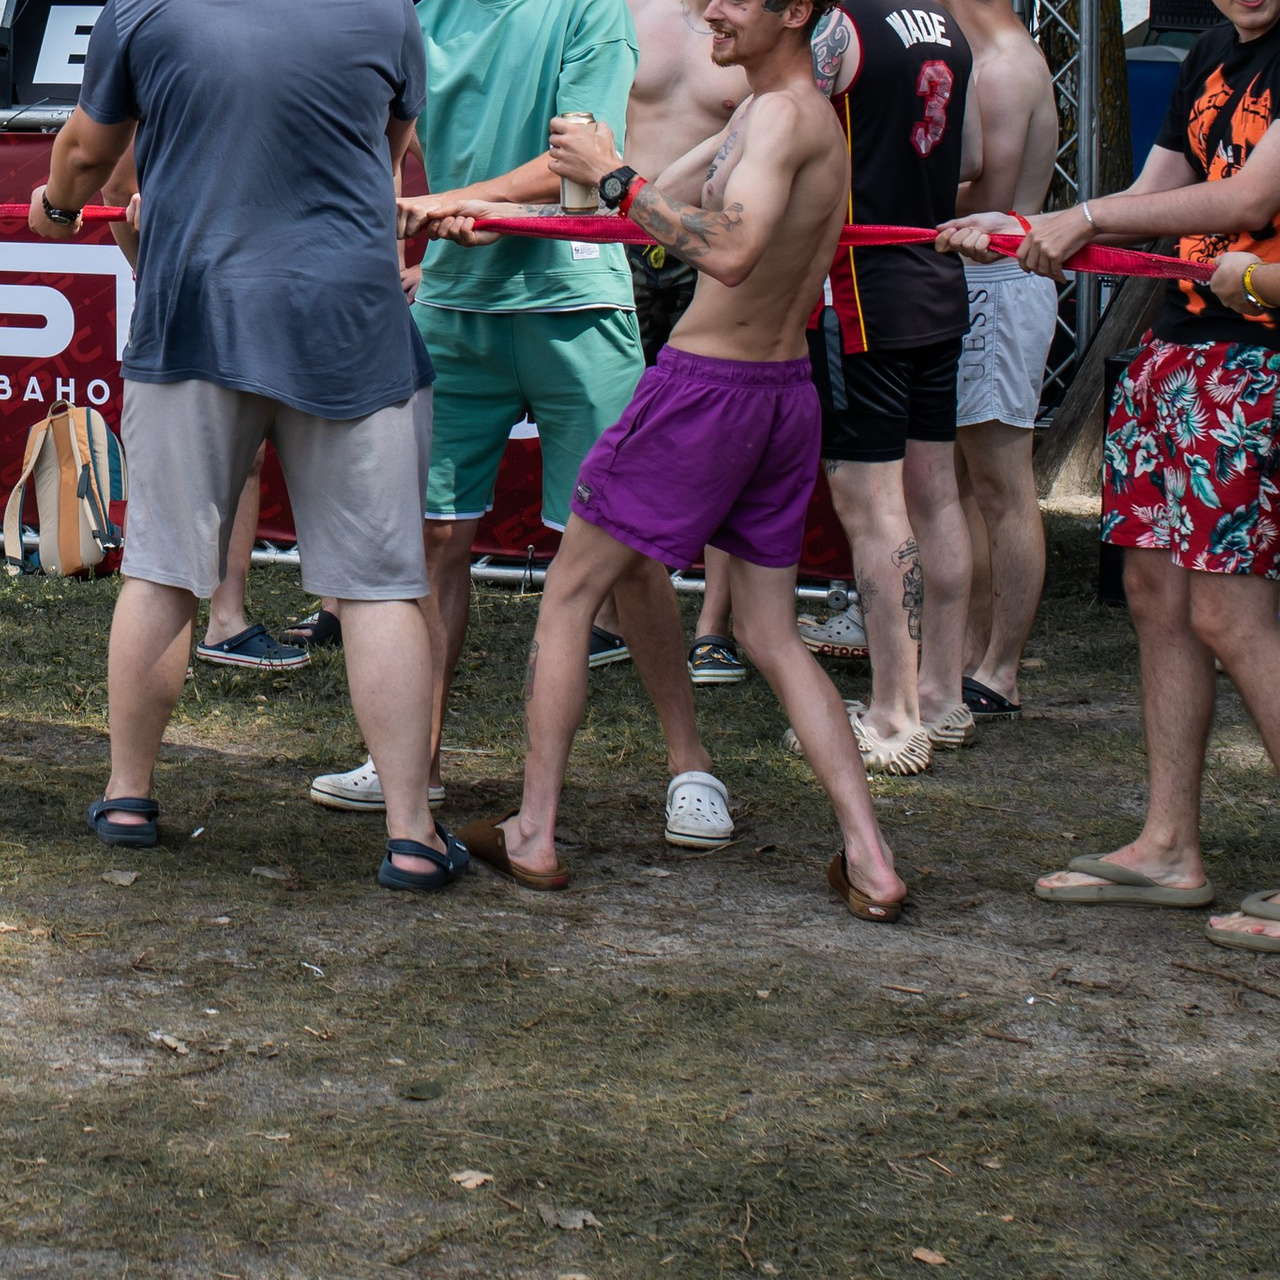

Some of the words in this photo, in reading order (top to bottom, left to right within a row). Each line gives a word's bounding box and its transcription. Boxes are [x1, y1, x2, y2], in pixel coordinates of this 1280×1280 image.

[885, 8, 952, 49] WADE
[909, 59, 955, 159] 3
[963, 288, 989, 385] UESS
[819, 644, 869, 658] crocs
